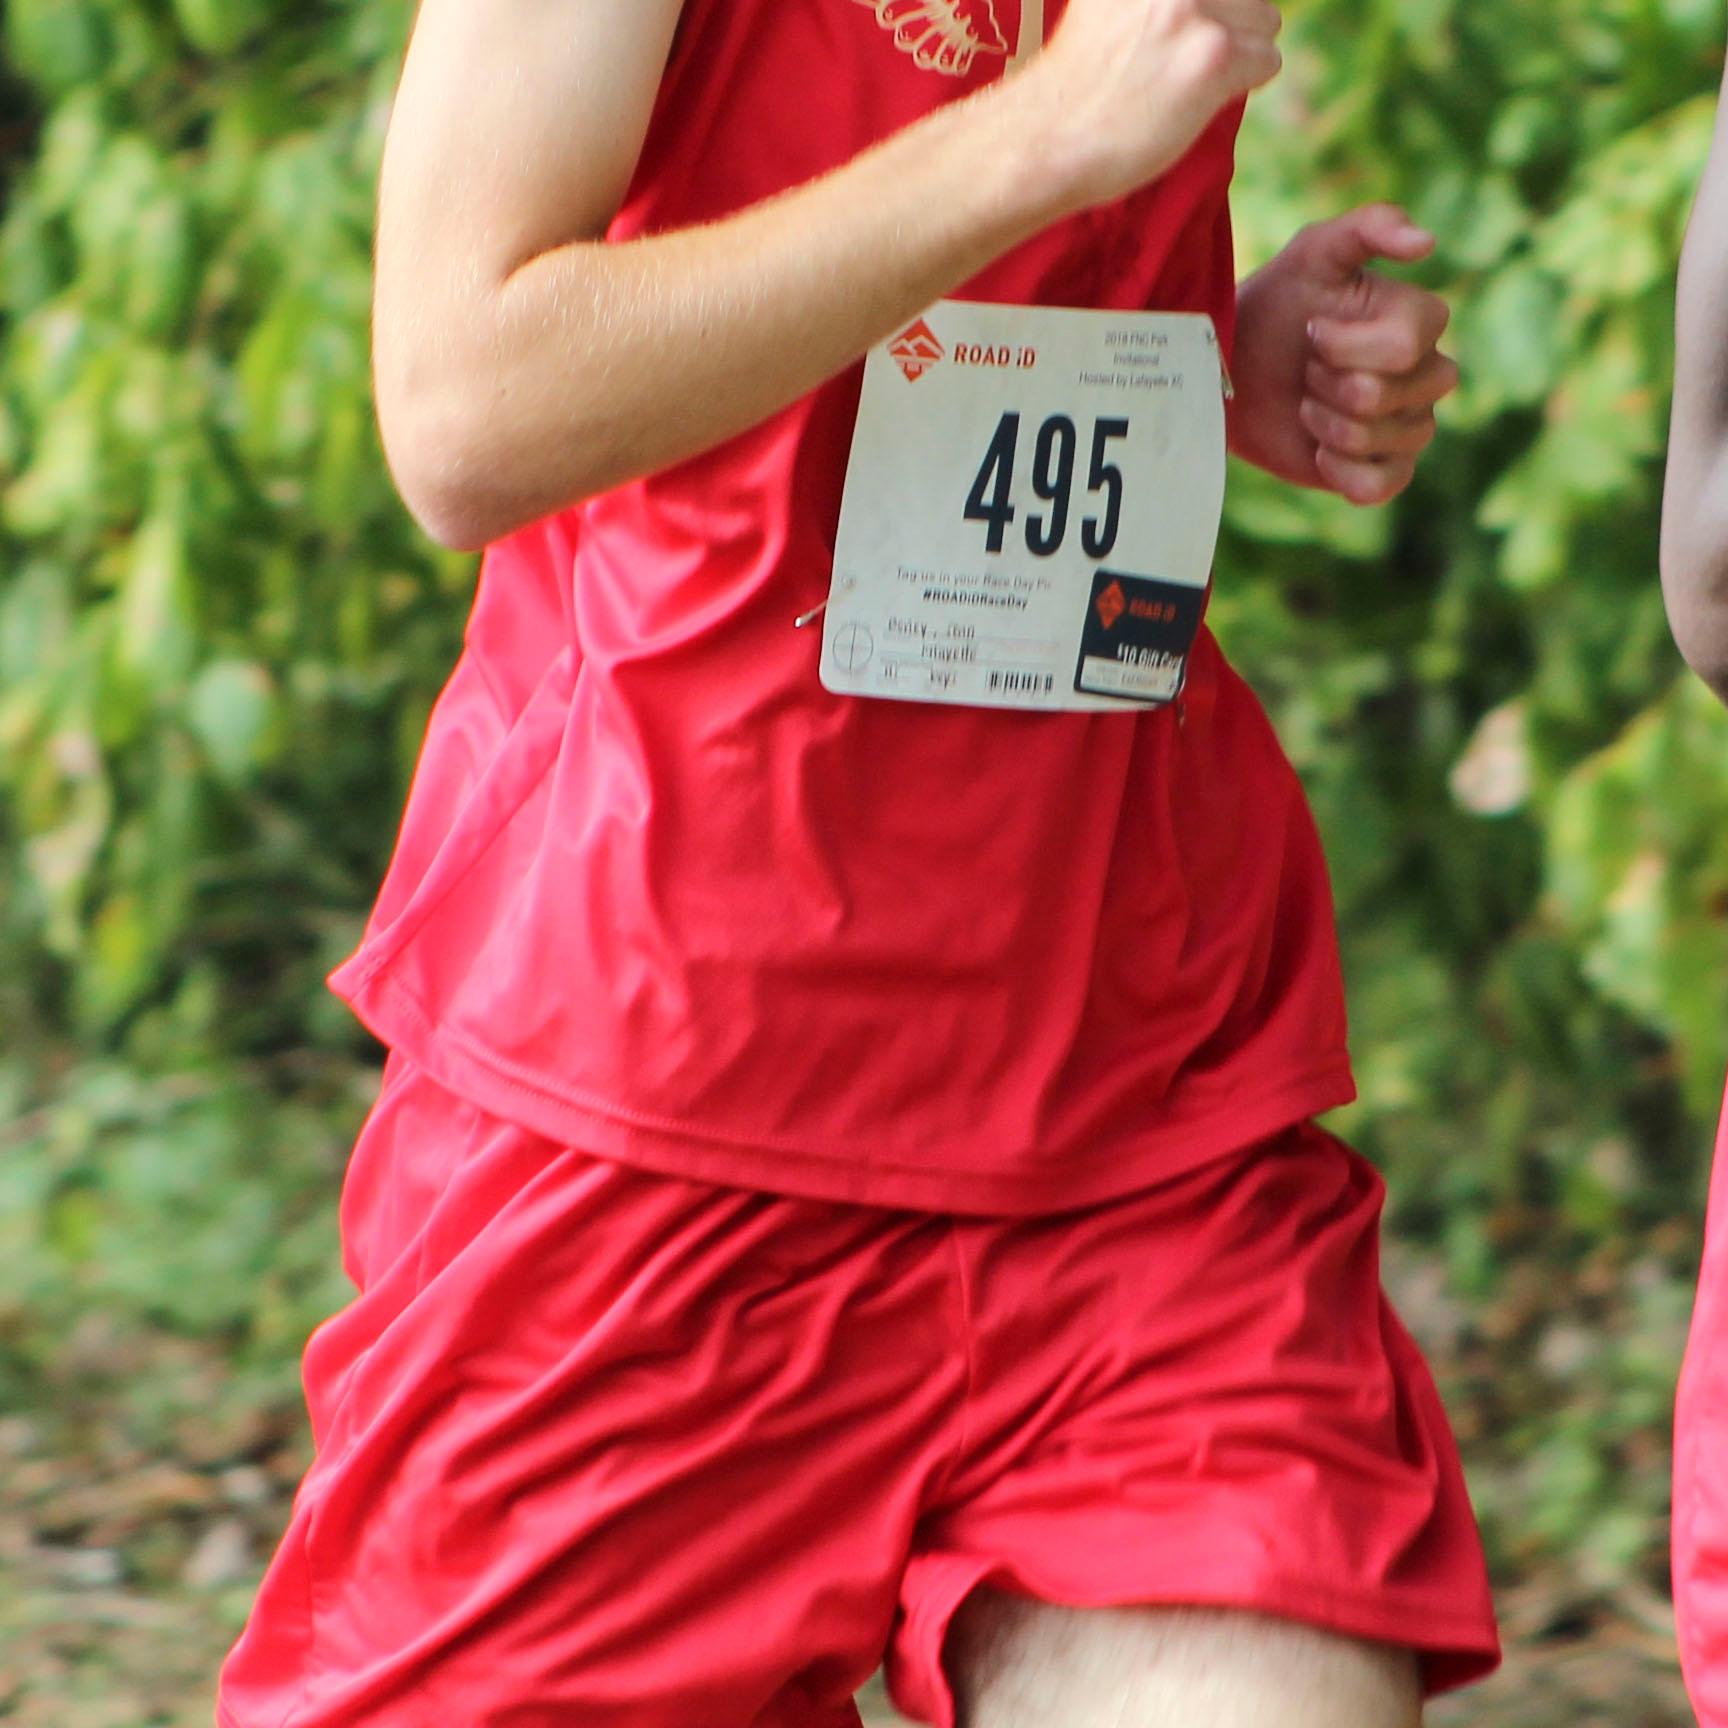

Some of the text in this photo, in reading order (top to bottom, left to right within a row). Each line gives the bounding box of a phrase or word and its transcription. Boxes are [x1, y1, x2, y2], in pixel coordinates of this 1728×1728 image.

[954, 343, 1011, 368] ROAD
[1079, 371, 1115, 385] Hosted
[963, 411, 1130, 559] 495
